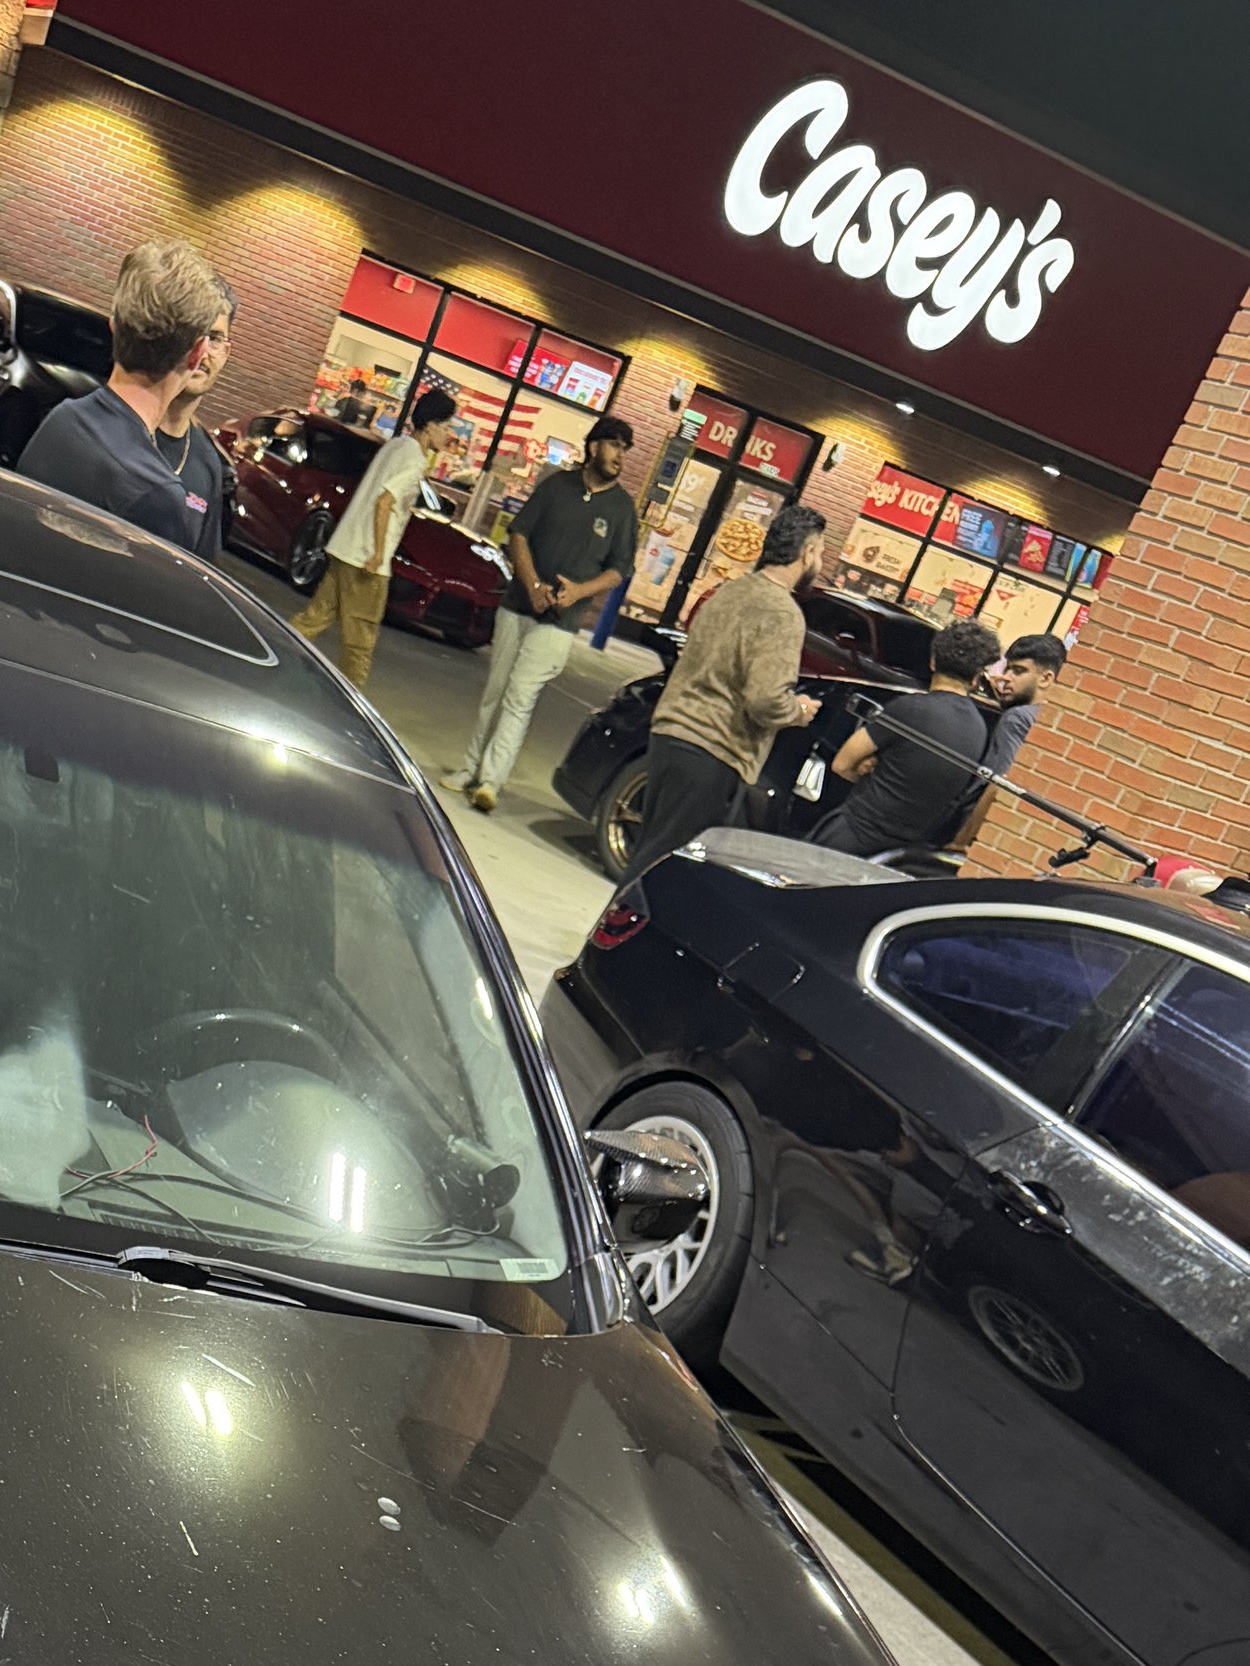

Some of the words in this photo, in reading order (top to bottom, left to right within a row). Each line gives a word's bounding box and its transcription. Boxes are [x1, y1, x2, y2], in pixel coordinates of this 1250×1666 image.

[724, 79, 1075, 352] Casey's
[708, 421, 777, 461] DRKS
[867, 480, 901, 507] sey's
